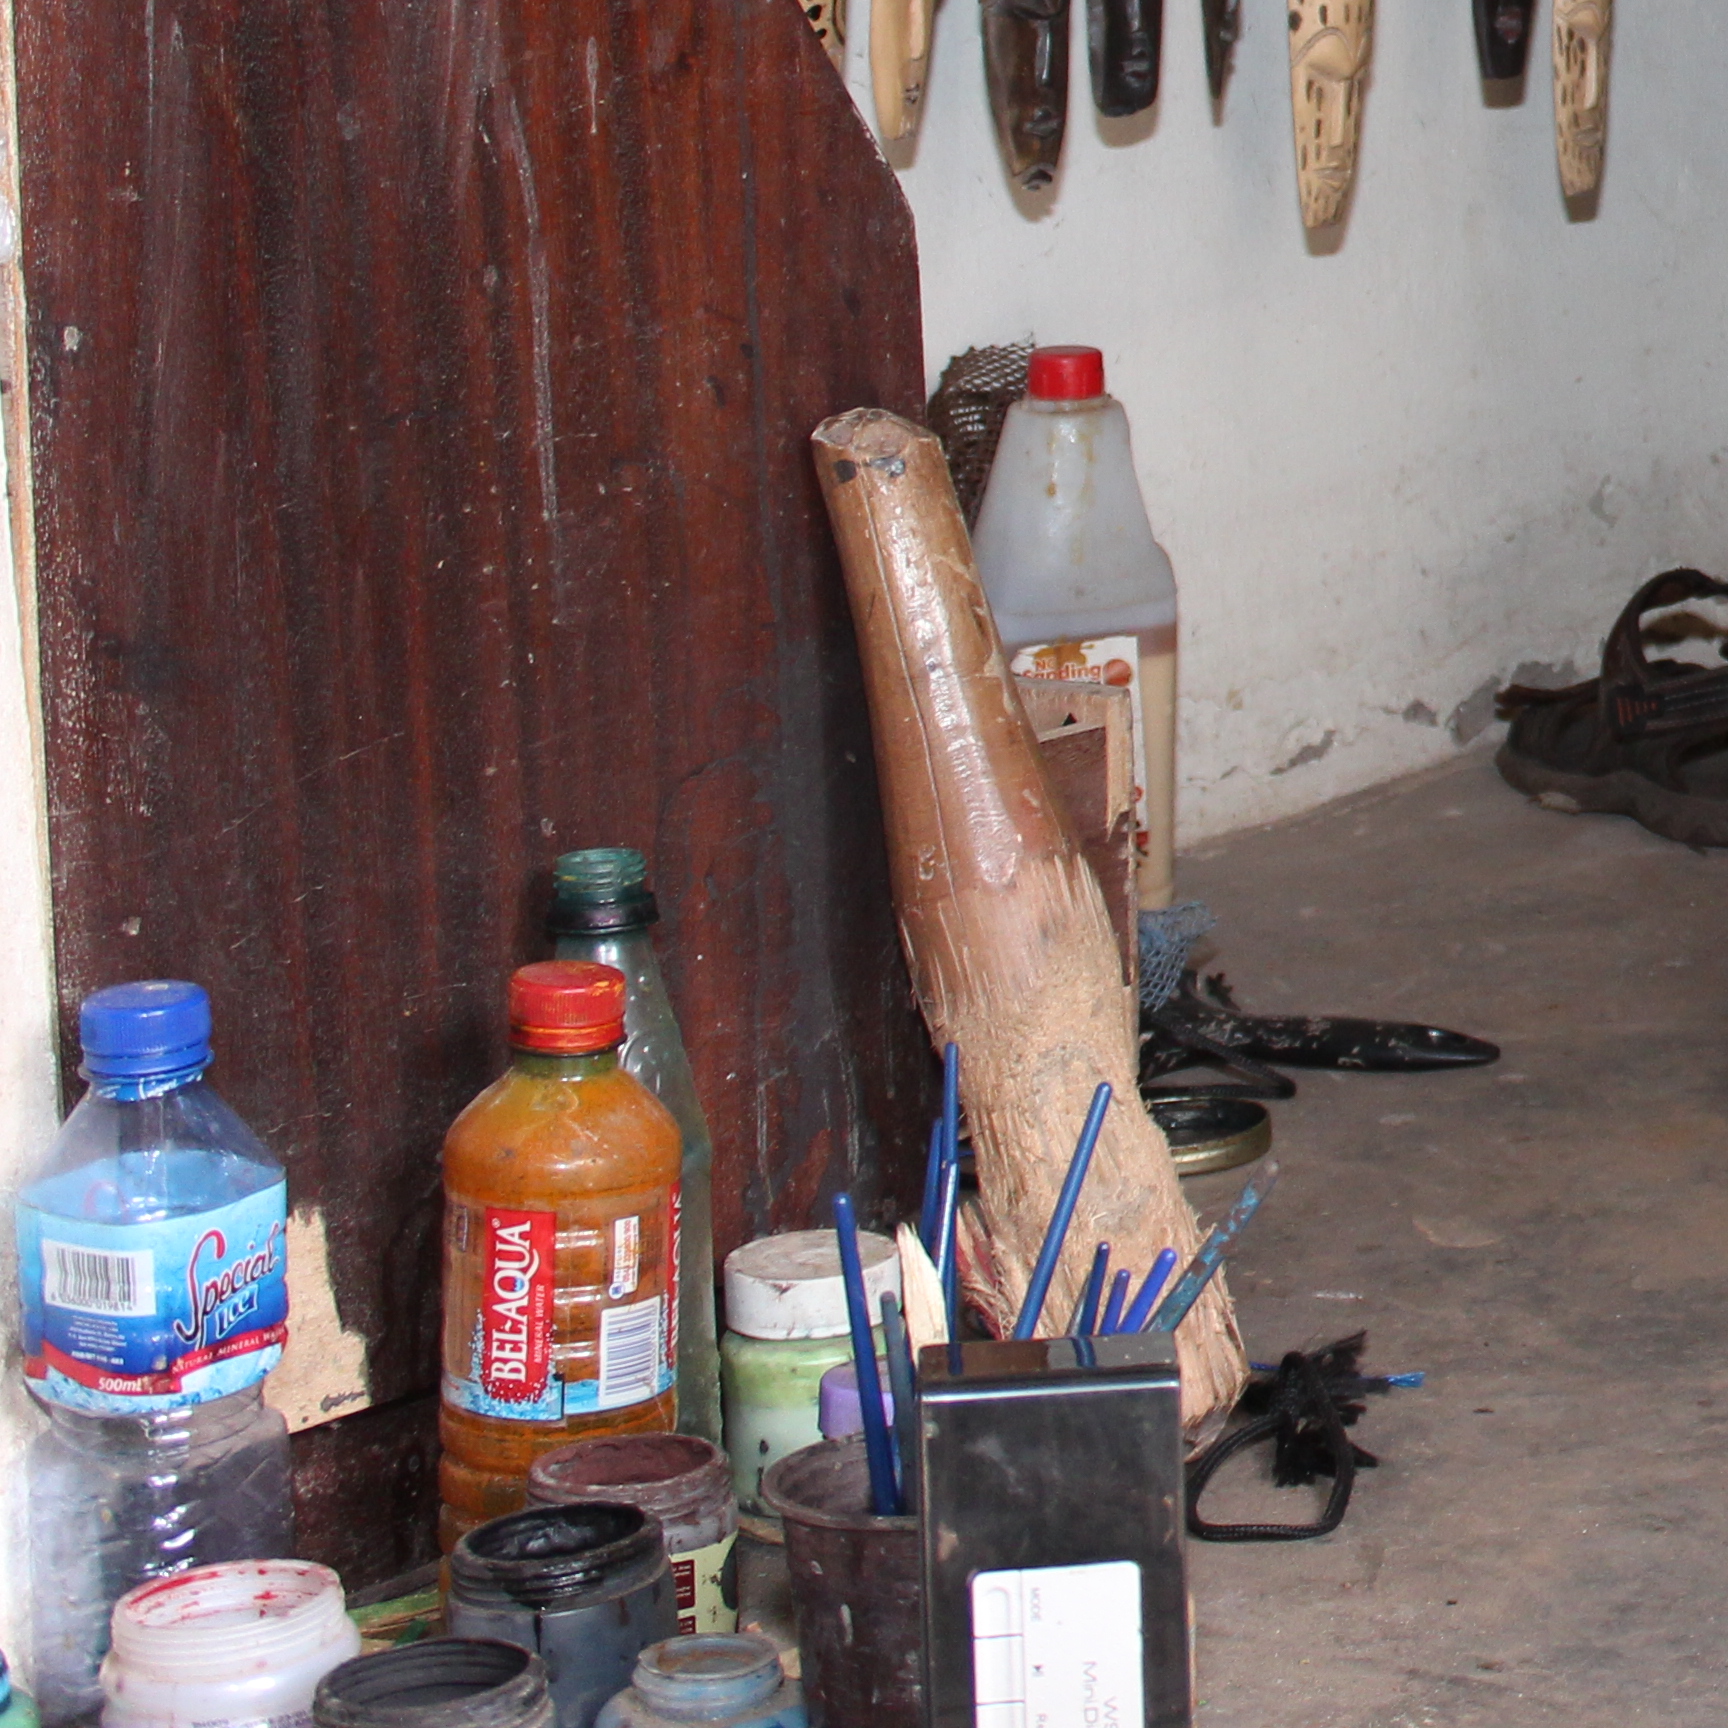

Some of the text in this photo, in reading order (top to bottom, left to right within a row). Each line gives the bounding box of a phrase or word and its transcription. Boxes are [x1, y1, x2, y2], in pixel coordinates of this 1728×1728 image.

[174, 1222, 281, 1351] Special
[217, 1336, 259, 1355] MINERAL
[533, 1284, 546, 1364] MINERAL WATER
[1030, 1587, 1041, 1622] MODE
